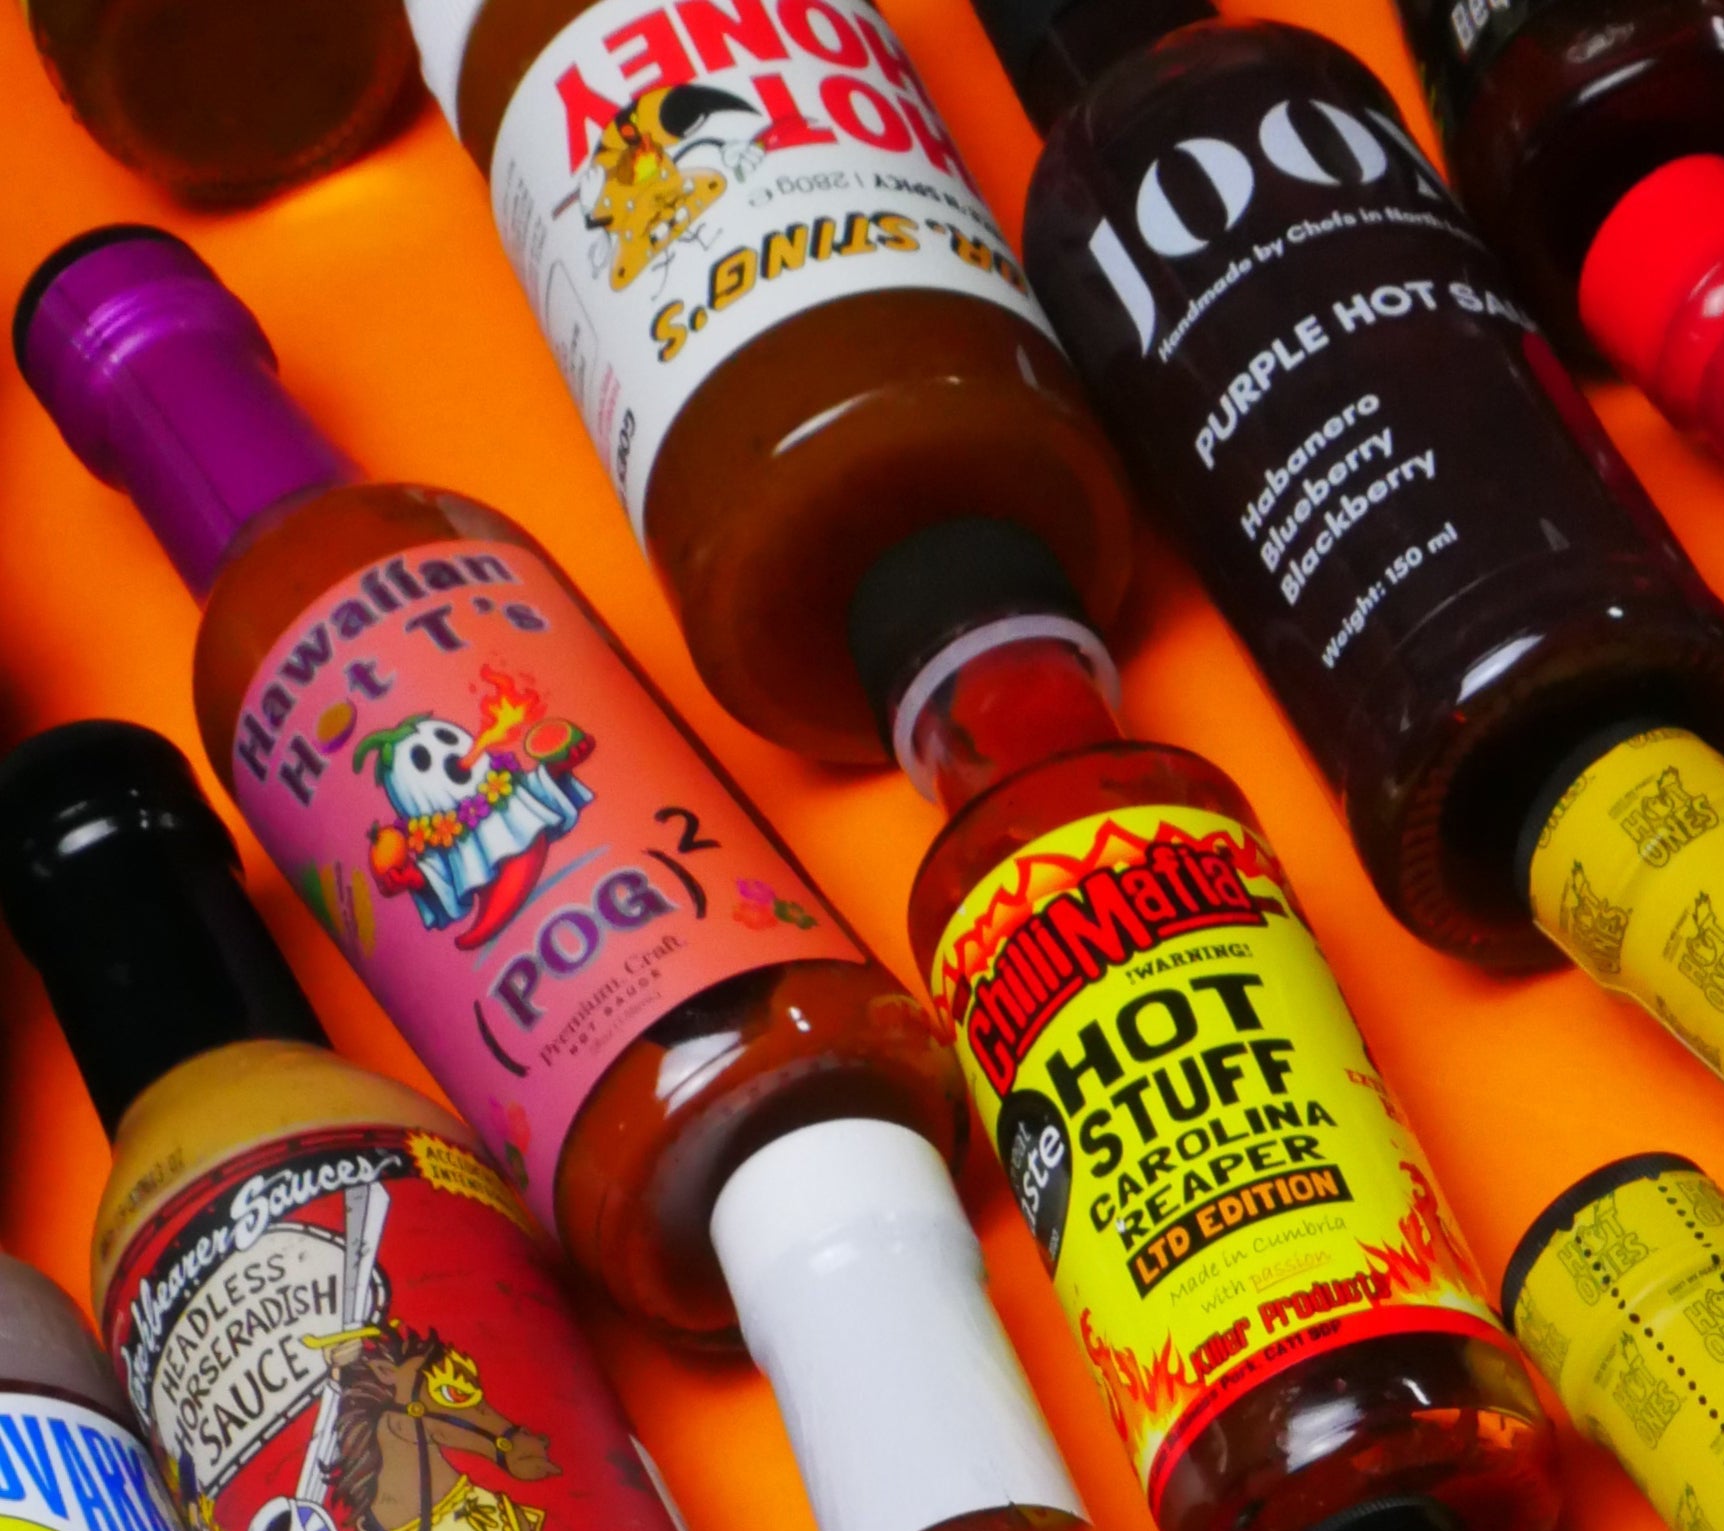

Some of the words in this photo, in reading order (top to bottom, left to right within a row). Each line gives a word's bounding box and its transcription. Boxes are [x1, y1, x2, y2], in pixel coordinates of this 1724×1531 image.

[1157, 256, 1253, 364] Handmade
[1255, 234, 1285, 263] by
[1286, 208, 1357, 246] Chefs
[1194, 313, 1329, 471] PURPLE
[1332, 280, 1438, 333] HOT
[1240, 392, 1380, 541] Habanero
[1259, 426, 1395, 573] Blueberry
[1280, 448, 1439, 606] Blackberry
[1320, 578, 1388, 670] Weight:
[1045, 973, 1266, 1119] HOT
[1078, 1039, 1296, 1180] STUFF
[1088, 1101, 1338, 1233] CAROLINA
[1116, 1134, 1327, 1251] REAPER
[1134, 1229, 1192, 1287] LTD
[1196, 1172, 1339, 1239] EDITION
[161, 1253, 288, 1395] HEADLESS
[172, 1274, 338, 1455] HORSERADISH
[1200, 1280, 1247, 1316] with
[197, 1332, 309, 1466] SAUCE
